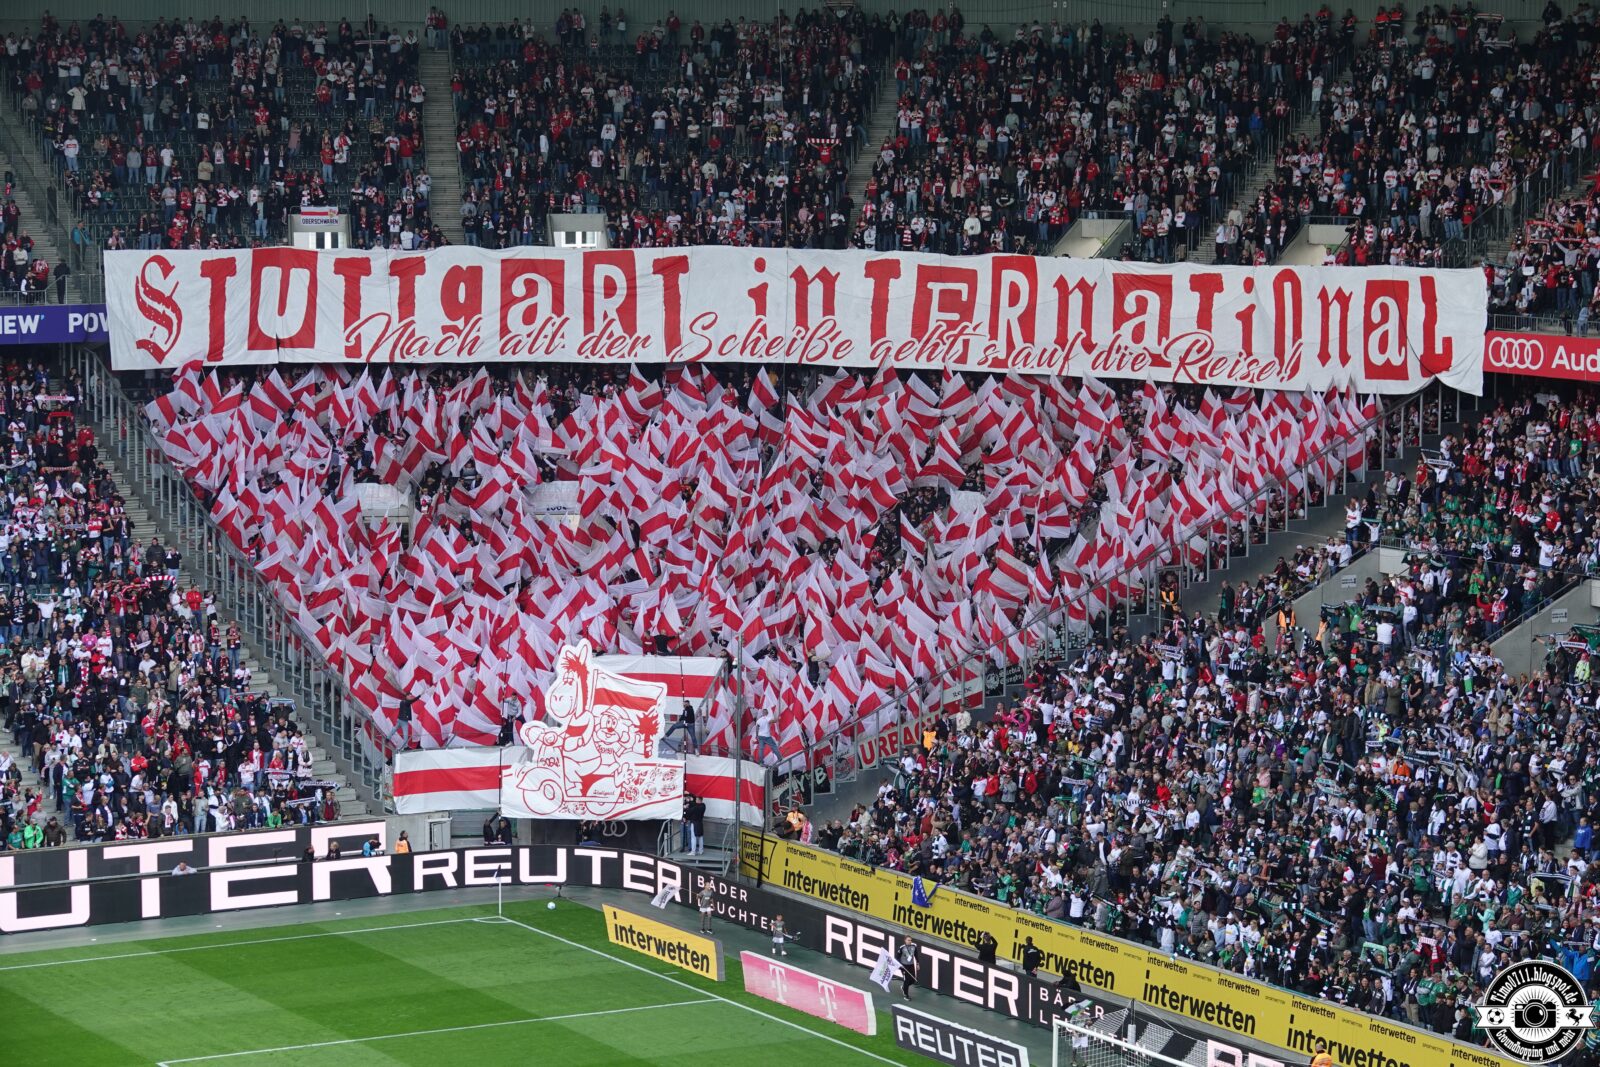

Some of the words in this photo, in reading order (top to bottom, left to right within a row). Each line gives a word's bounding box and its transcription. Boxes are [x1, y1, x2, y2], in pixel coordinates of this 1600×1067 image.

[345, 312, 484, 363] Nach
[500, 316, 570, 357] all
[577, 318, 651, 357] der
[670, 311, 855, 364] Scheiße
[1010, 330, 1087, 375] auf
[1091, 334, 1151, 372] die
[1162, 331, 1303, 384] Reise!
[745, 852, 769, 865] wettn
[786, 843, 817, 861] interwetten
[413, 848, 682, 903] REUTER
[840, 858, 873, 877] interwetten
[697, 875, 748, 903] BÄDER
[783, 858, 869, 911] interwetten
[697, 897, 776, 932] LUCHTE
[954, 893, 990, 914] interwetten
[1015, 912, 1053, 933] interwetten
[614, 911, 710, 974] interwetten
[1079, 931, 1119, 954] interwetten
[1012, 929, 1115, 990] inerwetten
[1147, 951, 1188, 975] interwetten
[1217, 972, 1260, 997] interwetten
[1143, 970, 1256, 1035] interwetten
[1291, 995, 1336, 1020] interwetten
[1369, 1018, 1417, 1045] interwetten
[1451, 1043, 1501, 1067] interwetten
